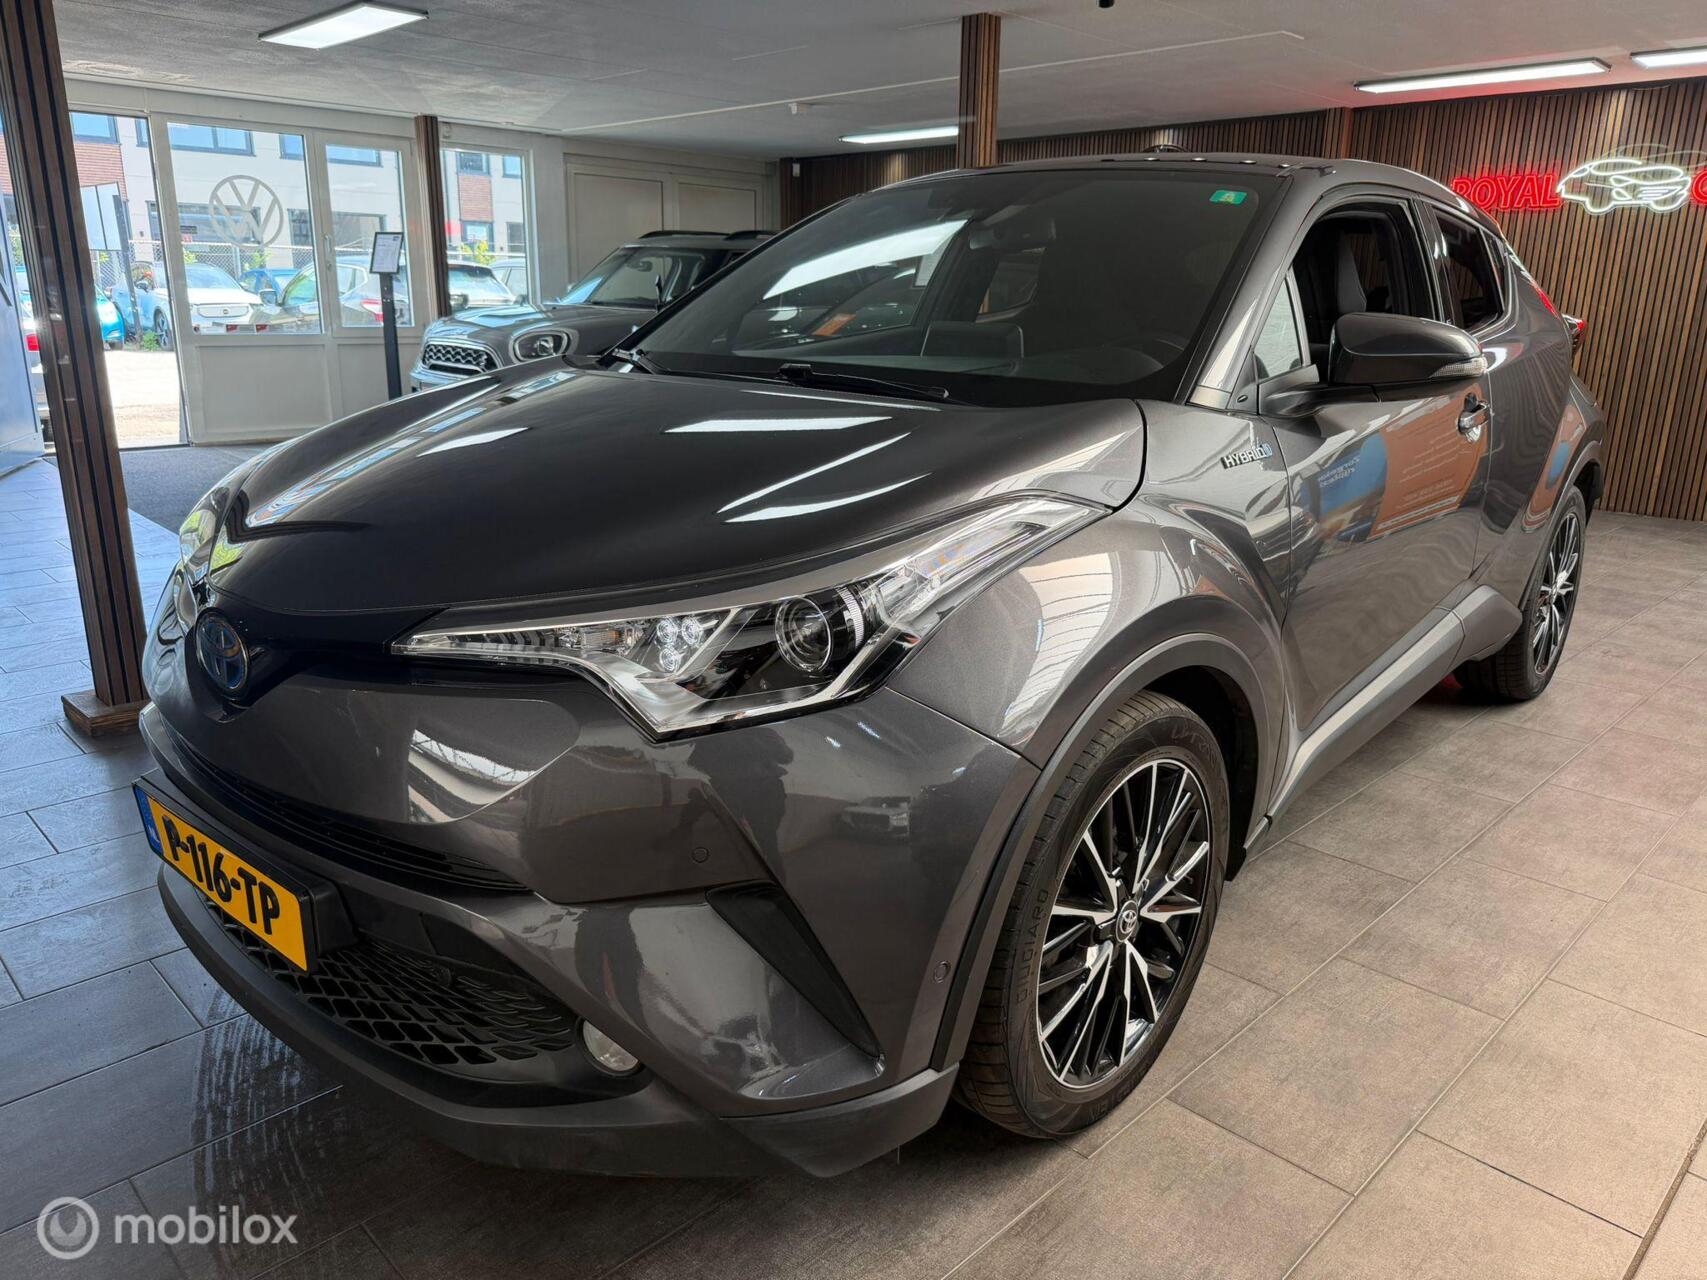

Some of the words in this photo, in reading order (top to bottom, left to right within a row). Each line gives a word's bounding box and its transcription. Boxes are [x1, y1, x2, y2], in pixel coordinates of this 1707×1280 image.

[1452, 174, 1561, 209] ROYAL
[1222, 446, 1267, 469] HYBRID
[162, 815, 280, 935] P-116-TP
